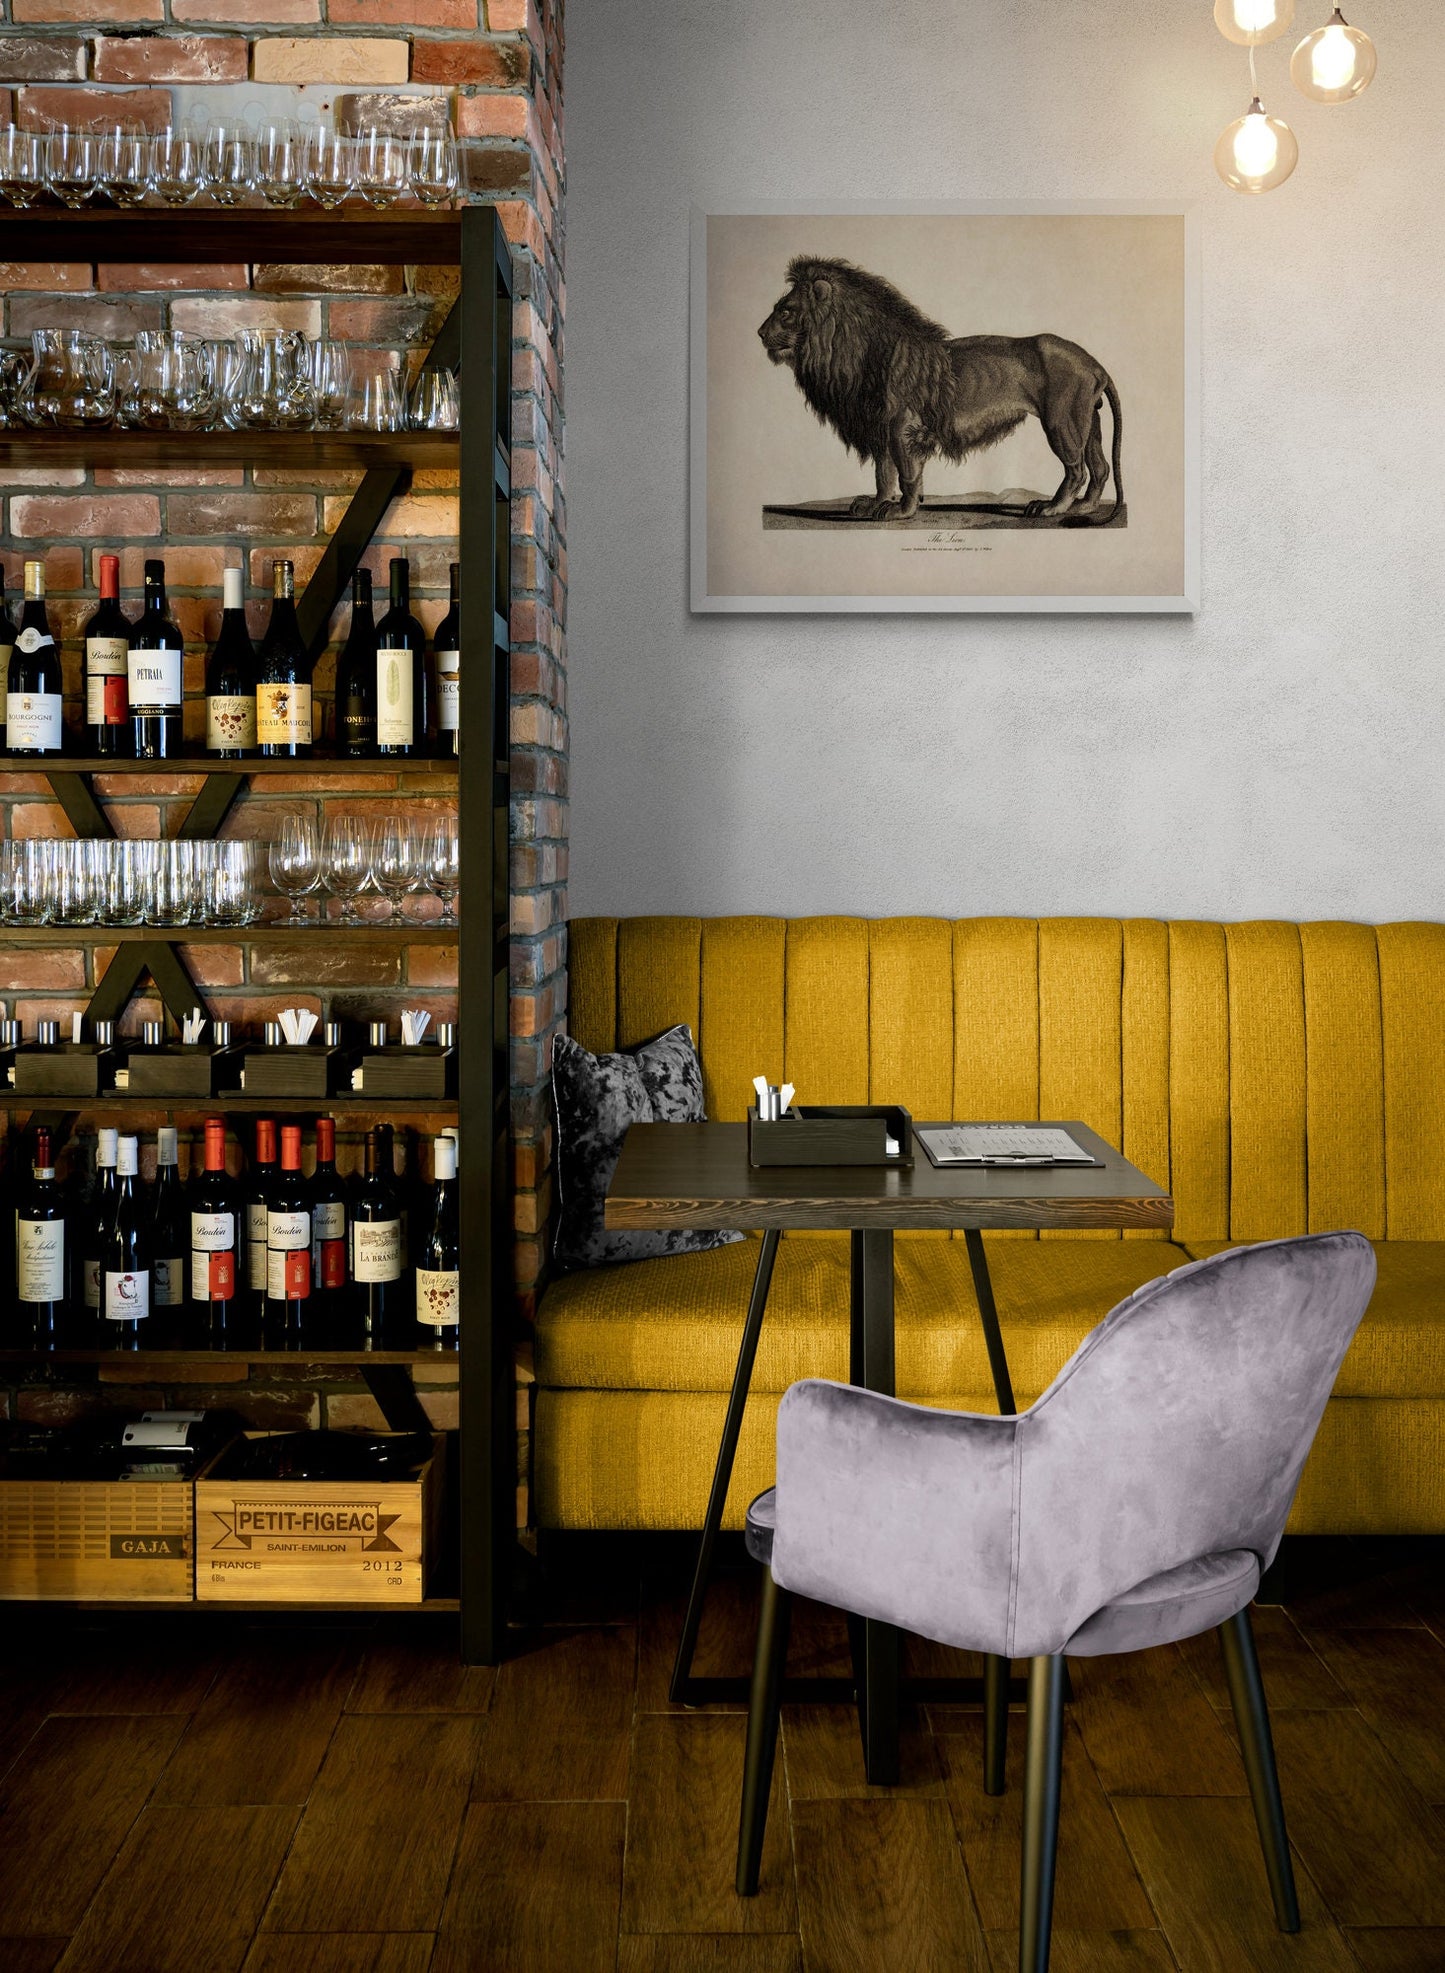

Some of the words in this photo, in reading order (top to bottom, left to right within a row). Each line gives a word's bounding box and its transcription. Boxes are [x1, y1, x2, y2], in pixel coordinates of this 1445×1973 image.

[195, 1226, 226, 1236] Bordón
[271, 1225, 302, 1235] Bordón
[239, 1511, 375, 1532] PETIT-FIGEAC
[121, 1540, 172, 1553] GAJA
[267, 1543, 347, 1552] SAINT-EMILION
[211, 1560, 262, 1570] FRANCE
[362, 1560, 404, 1572] 2012
